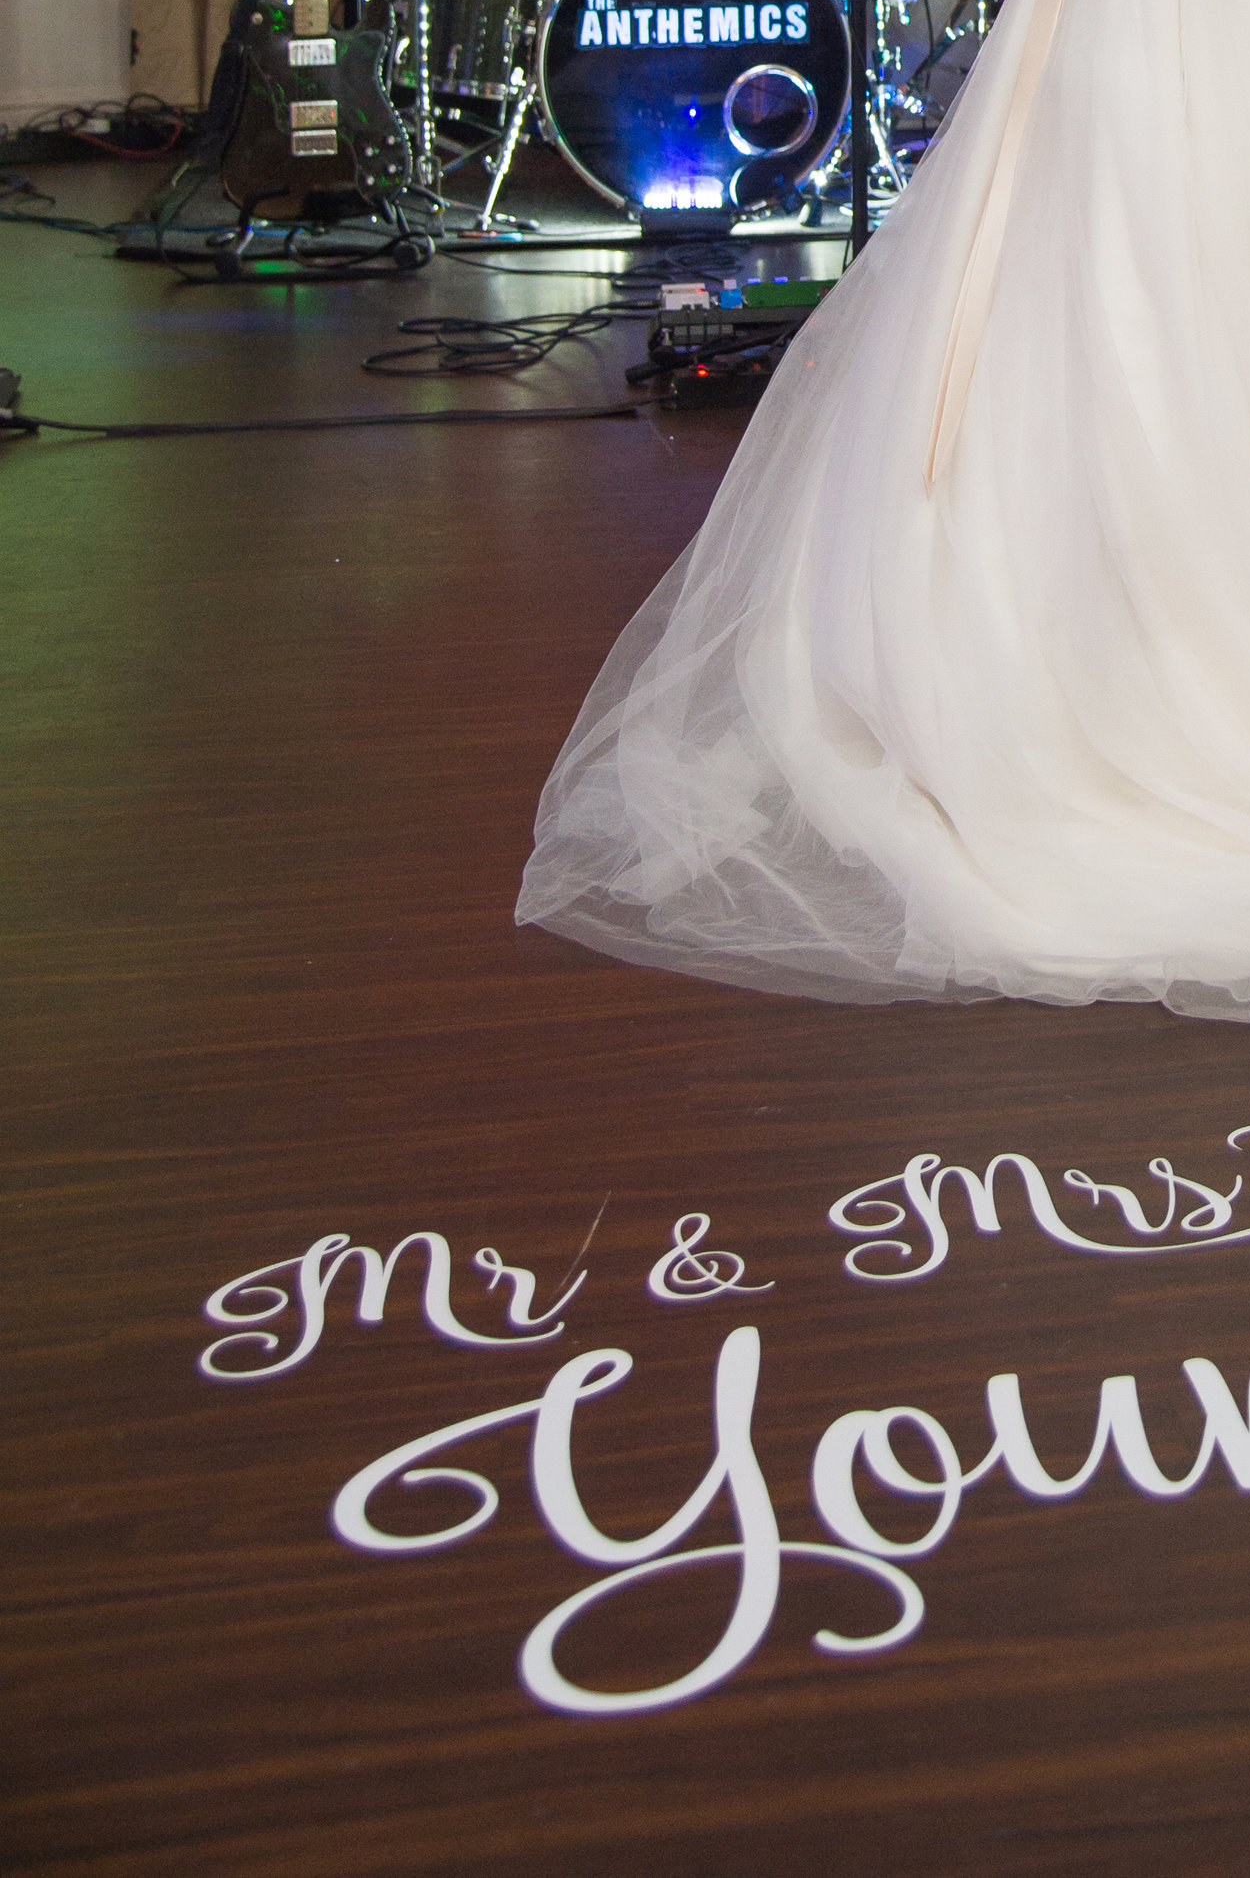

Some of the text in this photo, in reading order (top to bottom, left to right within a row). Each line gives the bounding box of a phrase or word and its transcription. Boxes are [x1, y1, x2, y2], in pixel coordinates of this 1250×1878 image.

[579, 3, 807, 46] ANTHEMICS
[199, 1231, 588, 1379] Mr
[648, 1212, 776, 1301] &
